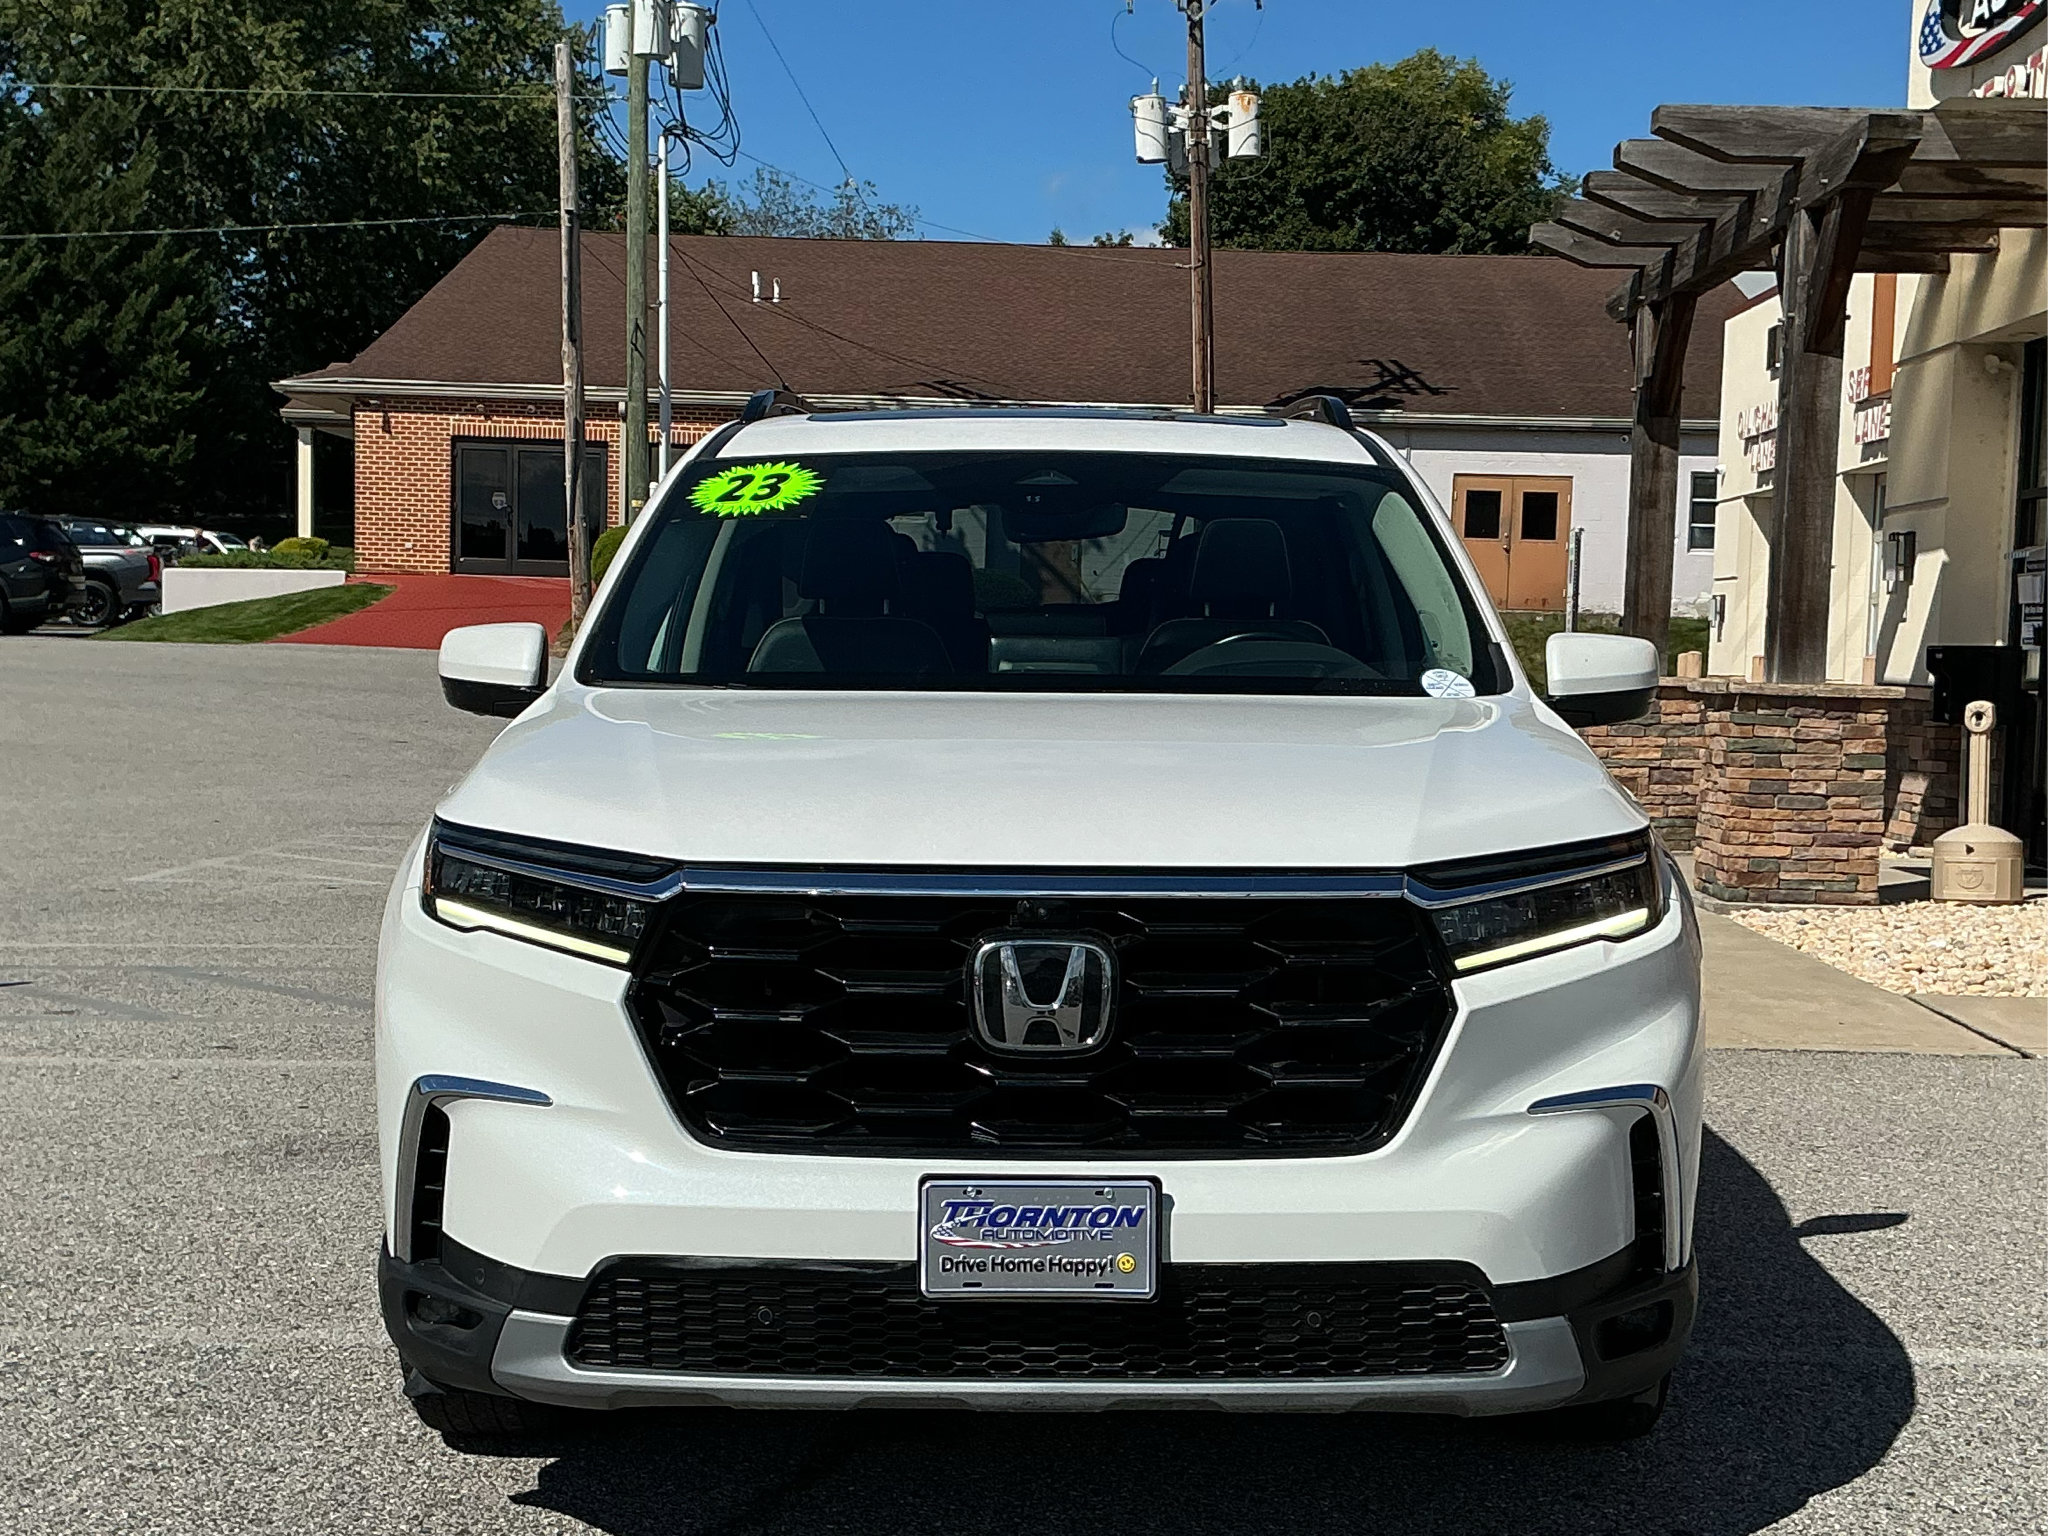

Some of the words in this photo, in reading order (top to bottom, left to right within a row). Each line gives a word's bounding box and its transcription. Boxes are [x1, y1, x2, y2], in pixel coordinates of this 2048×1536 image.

[1855, 402, 1892, 445] LANE
[714, 472, 792, 503] 23
[941, 1199, 1146, 1228] THORNTON
[980, 1228, 1114, 1242] AUTOMOTIVE
[940, 1255, 987, 1273] Drive
[991, 1256, 1045, 1273] Home
[1050, 1256, 1114, 1277] Happy!
